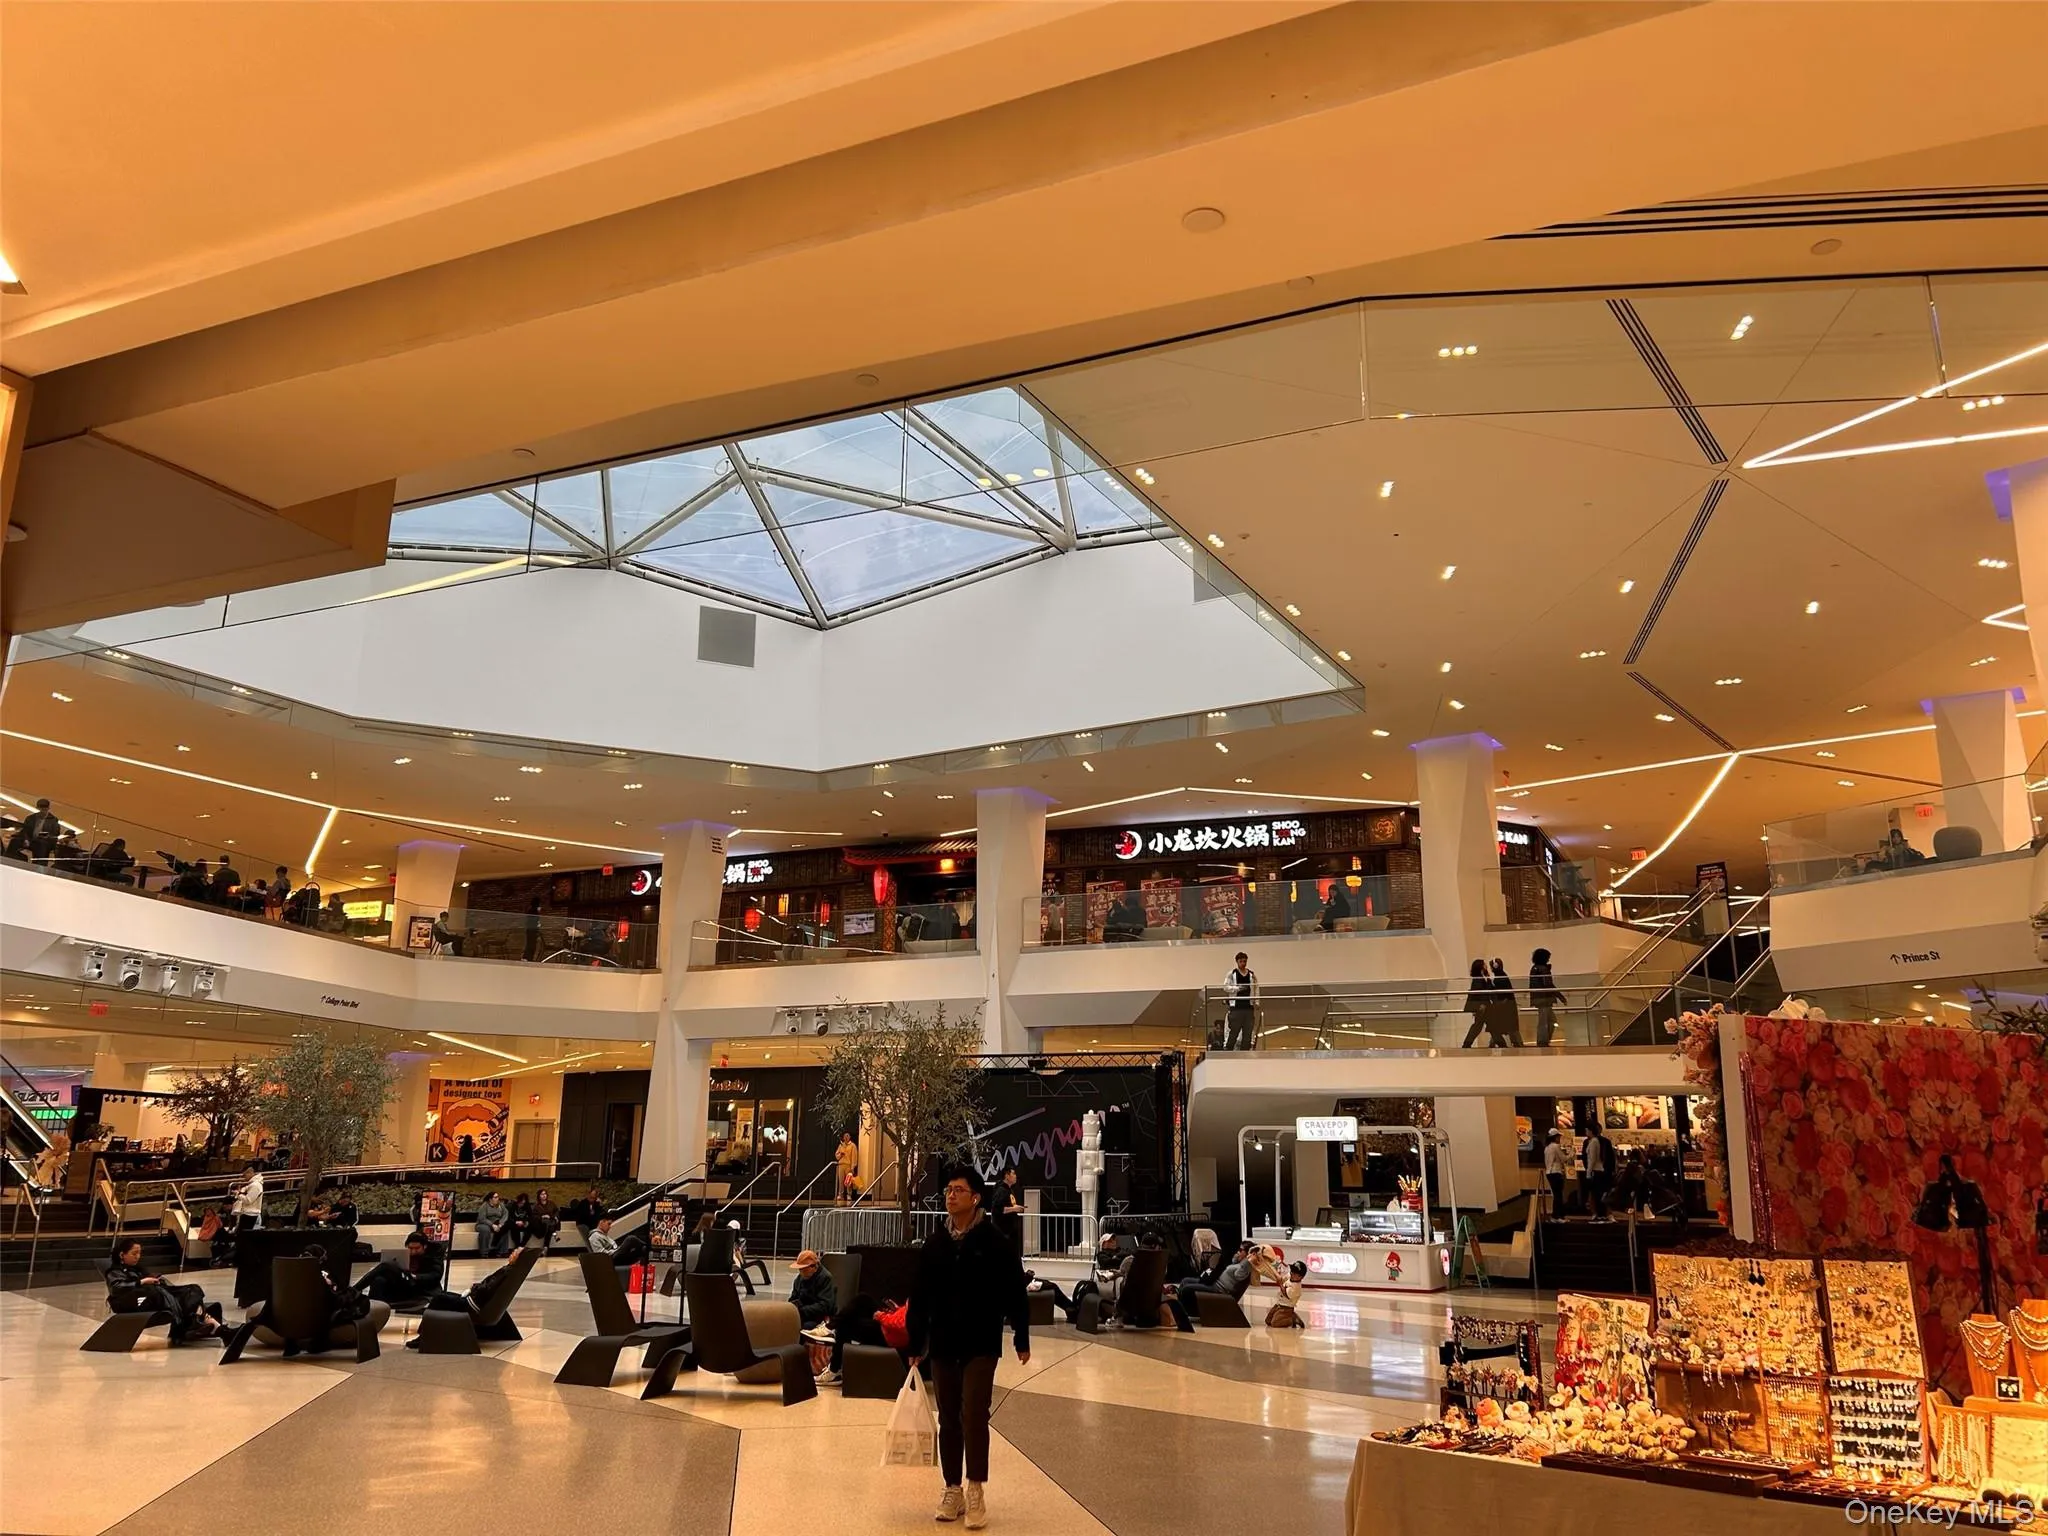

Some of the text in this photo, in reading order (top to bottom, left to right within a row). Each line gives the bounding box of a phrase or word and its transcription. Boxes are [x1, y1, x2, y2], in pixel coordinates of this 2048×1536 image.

[1272, 820, 1300, 831] SHOO
[1272, 828, 1307, 839] LOONG
[1504, 831, 1529, 845] KAN
[1148, 824, 1270, 854] 小龙坎火锅
[1272, 837, 1296, 847] KAN
[747, 859, 770, 868] SHOO
[746, 874, 765, 883] KAN
[1902, 950, 1941, 963] Prince St
[443, 1089, 503, 1099] designer toys
[1304, 1121, 1348, 1129] CRAVEPOP
